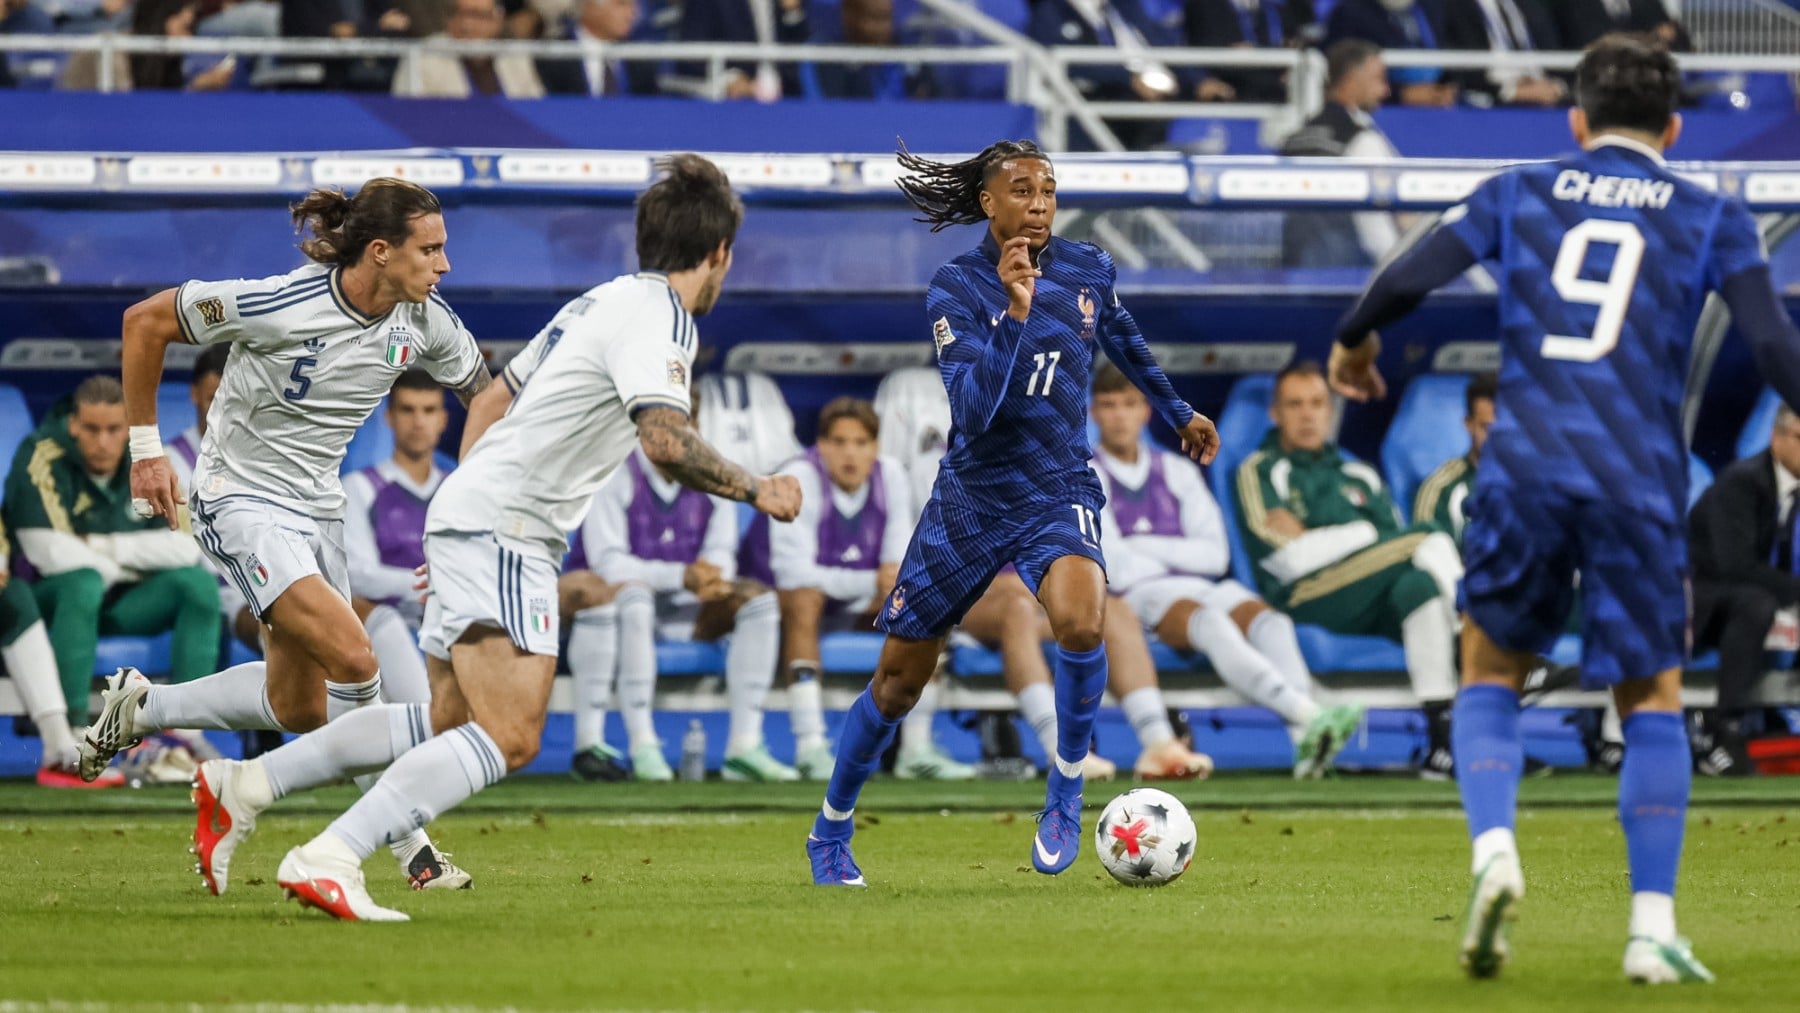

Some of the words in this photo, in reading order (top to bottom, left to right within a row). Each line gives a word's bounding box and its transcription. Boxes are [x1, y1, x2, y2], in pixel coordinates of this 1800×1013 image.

[1552, 169, 1674, 210] CHERKI
[1540, 218, 1647, 363] 9
[391, 334, 410, 343] ITALIA
[284, 357, 318, 400] 5
[1026, 351, 1061, 396] 11
[1071, 504, 1098, 544] 11
